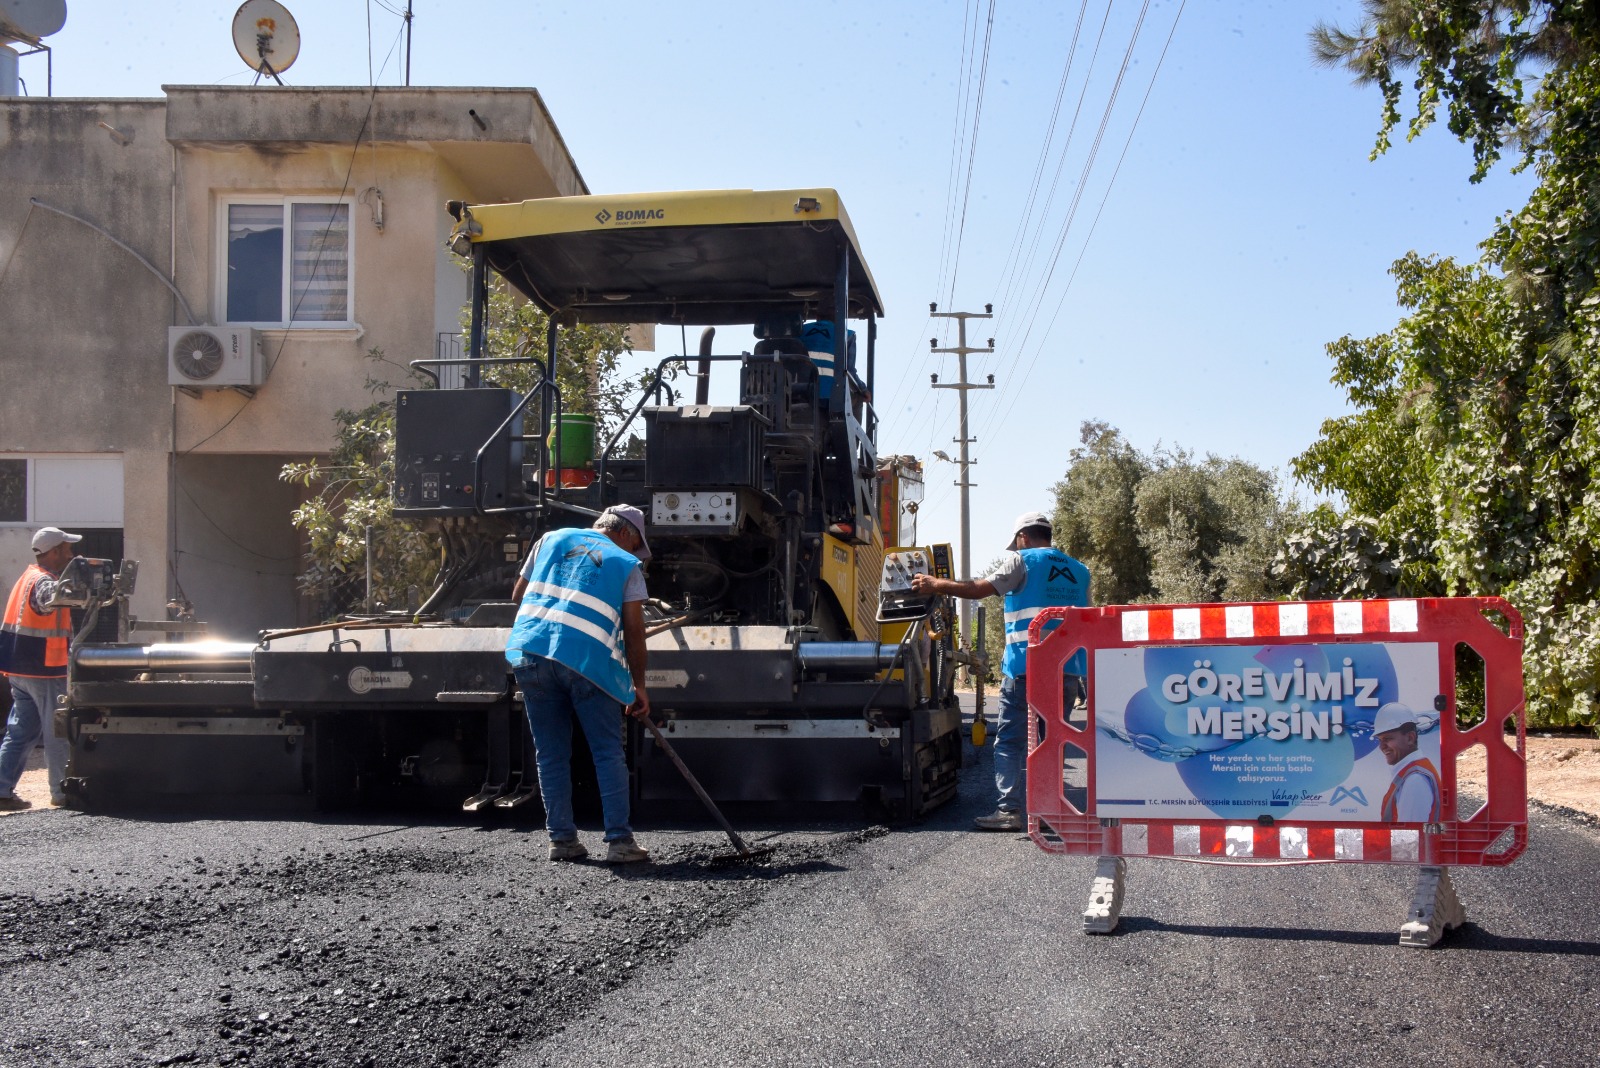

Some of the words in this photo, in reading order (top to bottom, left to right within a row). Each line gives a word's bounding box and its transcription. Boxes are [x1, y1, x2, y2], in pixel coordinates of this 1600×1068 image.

[616, 209, 664, 221] BOMAG
[1162, 657, 1379, 707] GÖREVİMİZ
[1187, 703, 1343, 741] MERSİN!
[1209, 754, 1225, 762] Her
[1227, 754, 1253, 764] yerde
[1268, 754, 1283, 762] her
[1286, 754, 1315, 763] şartta,
[1212, 764, 1242, 772] Mersin
[1244, 764, 1259, 773] için
[1261, 764, 1286, 772] canla
[1288, 764, 1313, 773] başla
[1237, 774, 1287, 783] çalışıyoruz.
[1161, 798, 1186, 806] MERSİN
[1188, 798, 1231, 807] BÜYÜKŞEHİR
[1232, 798, 1268, 806] BELEDİYESİ
[1271, 789, 1299, 806] Vahap
[1300, 789, 1323, 802] Seçer
